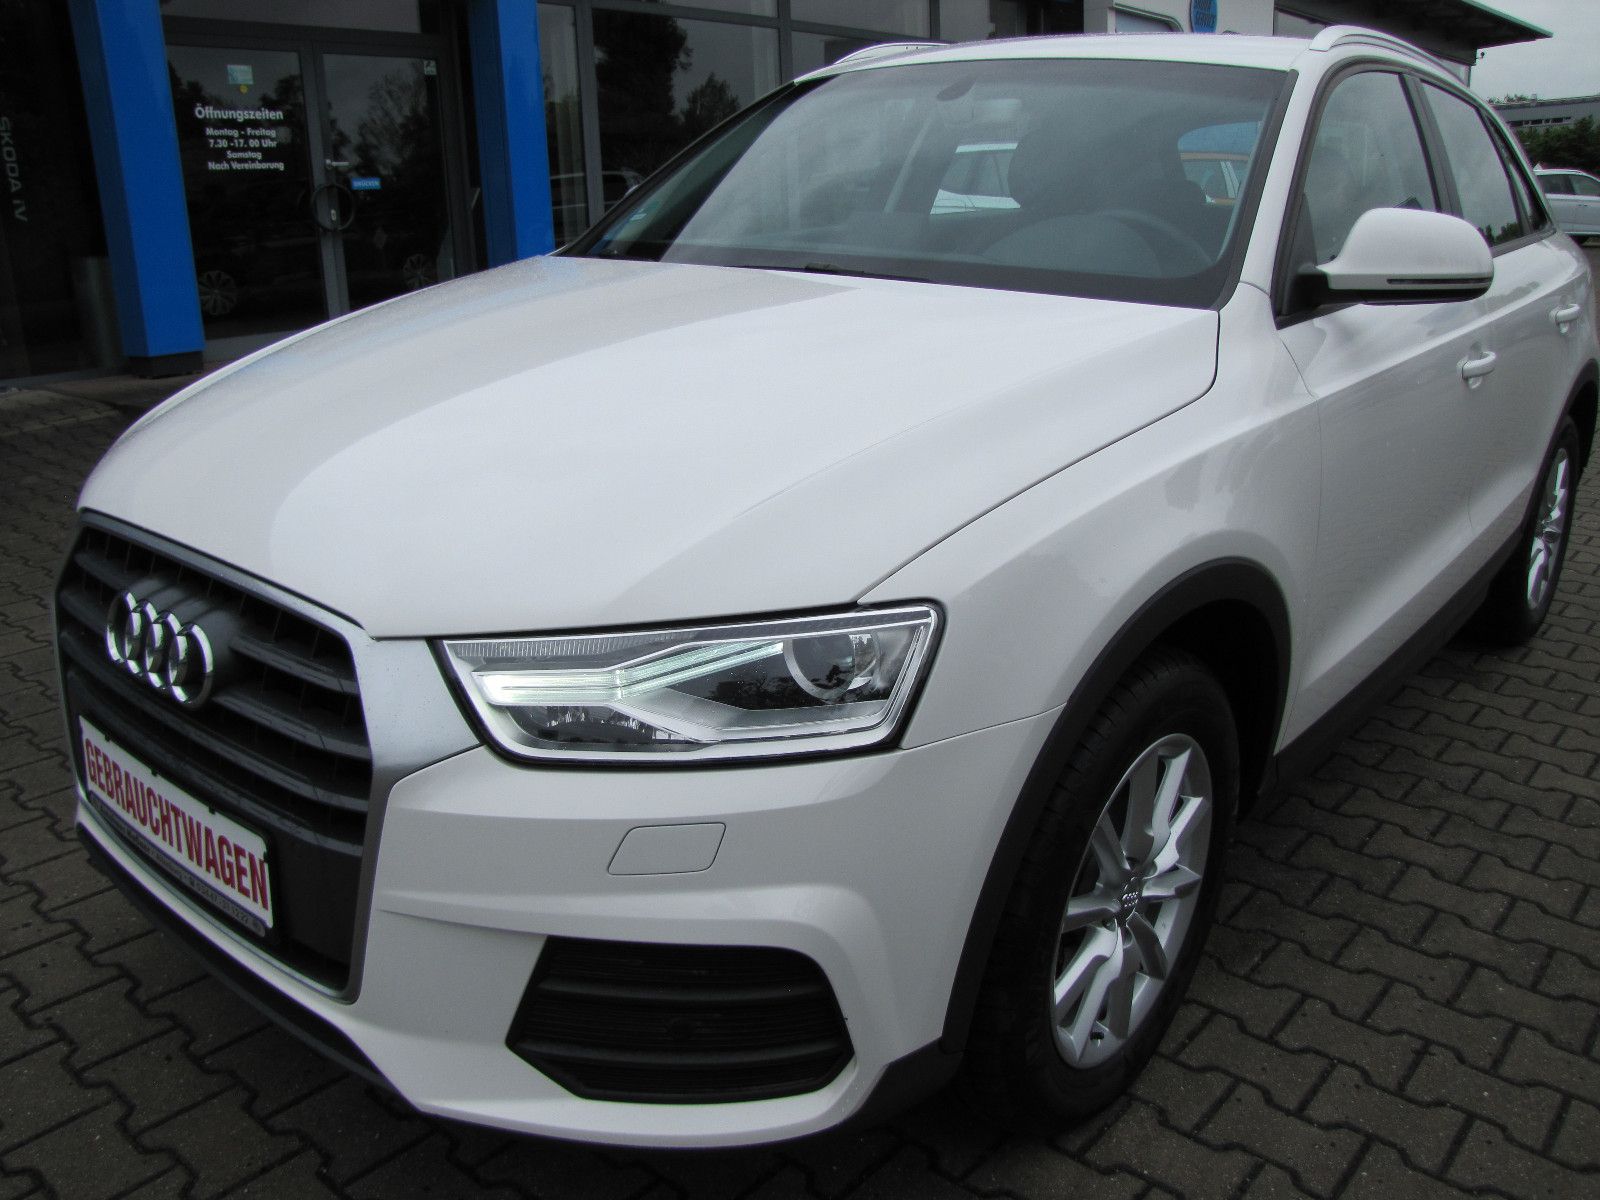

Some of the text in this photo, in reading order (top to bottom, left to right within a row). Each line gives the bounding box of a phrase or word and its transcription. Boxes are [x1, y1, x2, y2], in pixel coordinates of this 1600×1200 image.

[194, 103, 284, 122] Öffnungszeiten
[206, 128, 239, 138] Montag
[246, 128, 277, 138] Freitag
[261, 139, 278, 148] Uhr
[226, 150, 262, 160] Samstag
[208, 161, 285, 171] Nach Vereinbarung
[85, 738, 269, 911] GEBRAUCHTWAGEN
